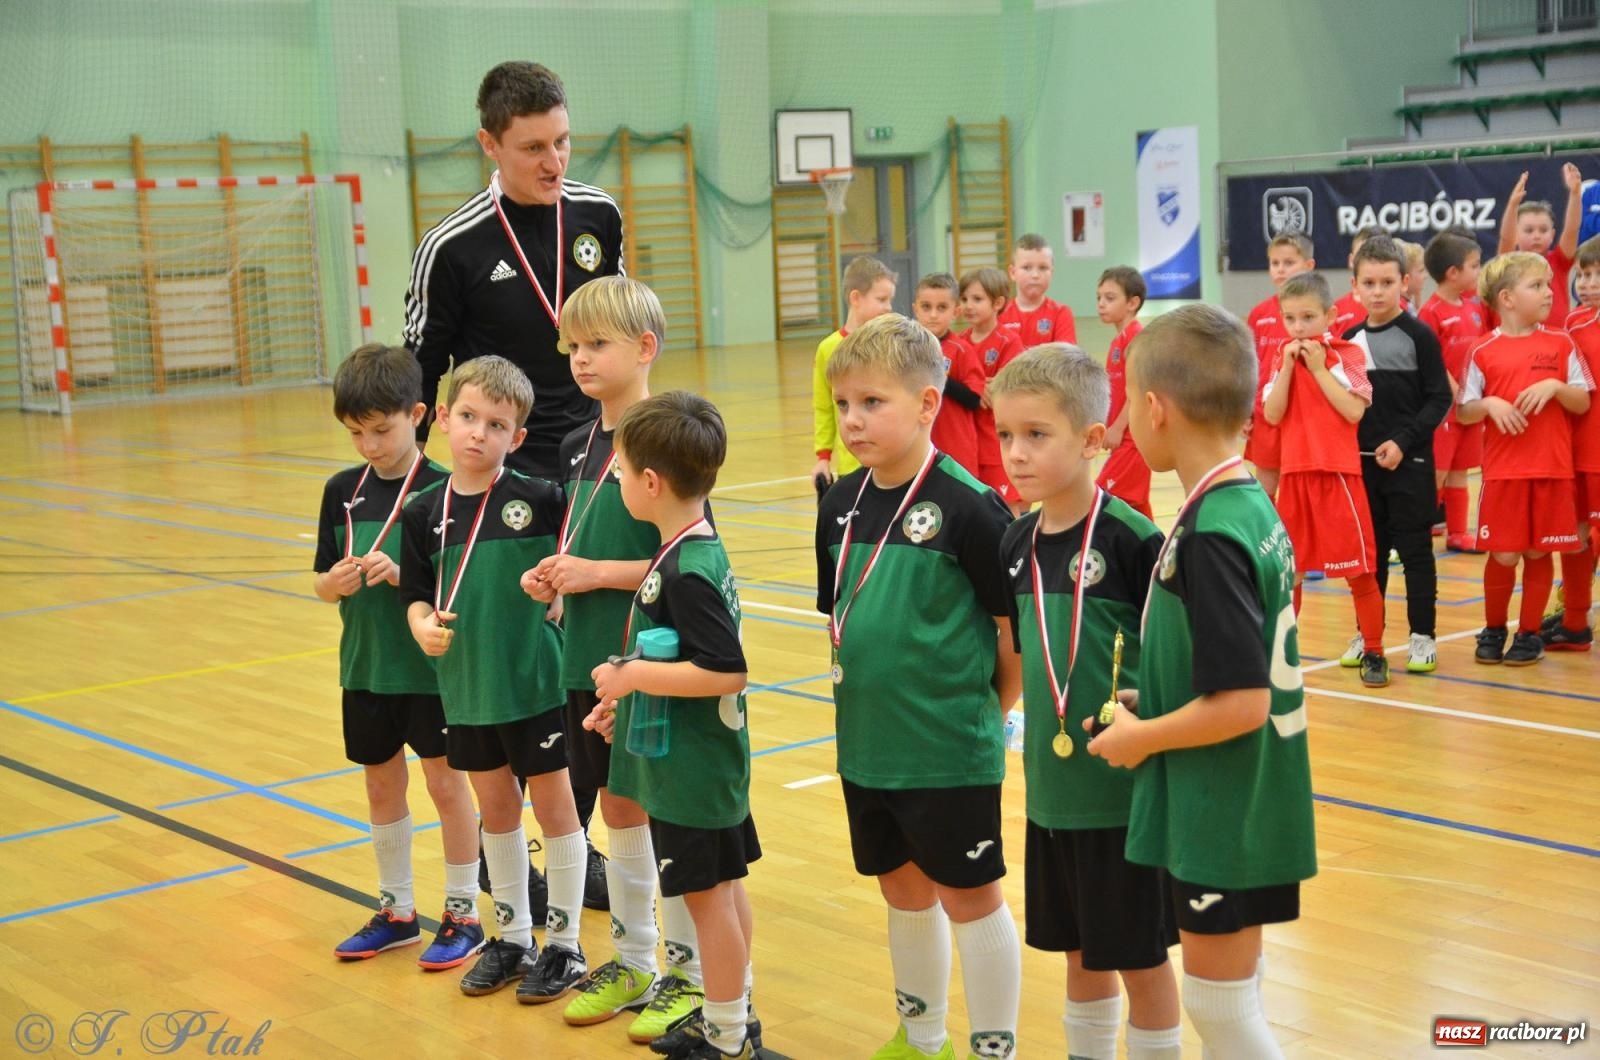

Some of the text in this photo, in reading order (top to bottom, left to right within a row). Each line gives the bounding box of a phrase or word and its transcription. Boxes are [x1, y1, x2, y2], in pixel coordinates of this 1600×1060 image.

[1337, 190, 1497, 235] RACIBÓRZ
[490, 269, 517, 281] adidas
[1480, 525, 1490, 540] 6
